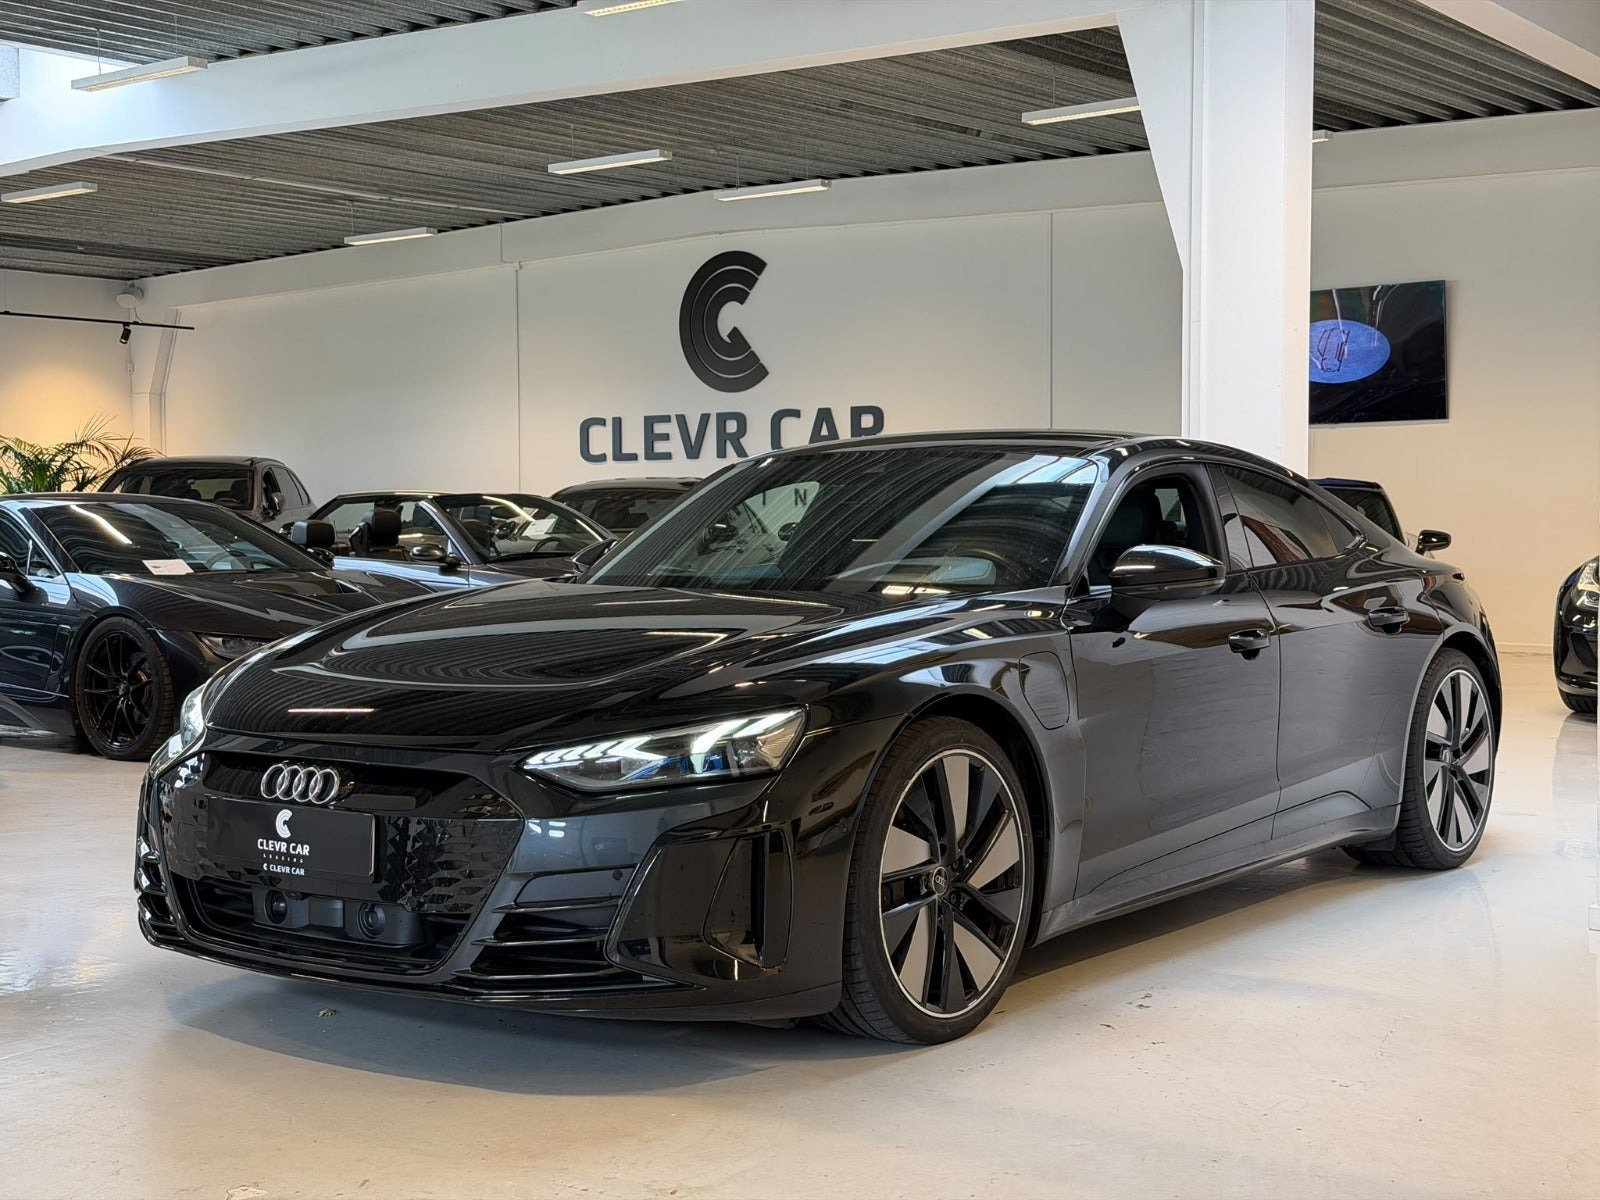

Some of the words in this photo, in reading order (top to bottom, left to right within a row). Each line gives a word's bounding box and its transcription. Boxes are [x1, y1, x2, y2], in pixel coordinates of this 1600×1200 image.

[579, 411, 749, 463] CLEVR
[770, 405, 885, 450] CAR
[257, 838, 287, 853] CLEVR
[289, 843, 310, 856] CAR
[269, 864, 290, 874] CLEVR
[291, 867, 305, 876] CAR
